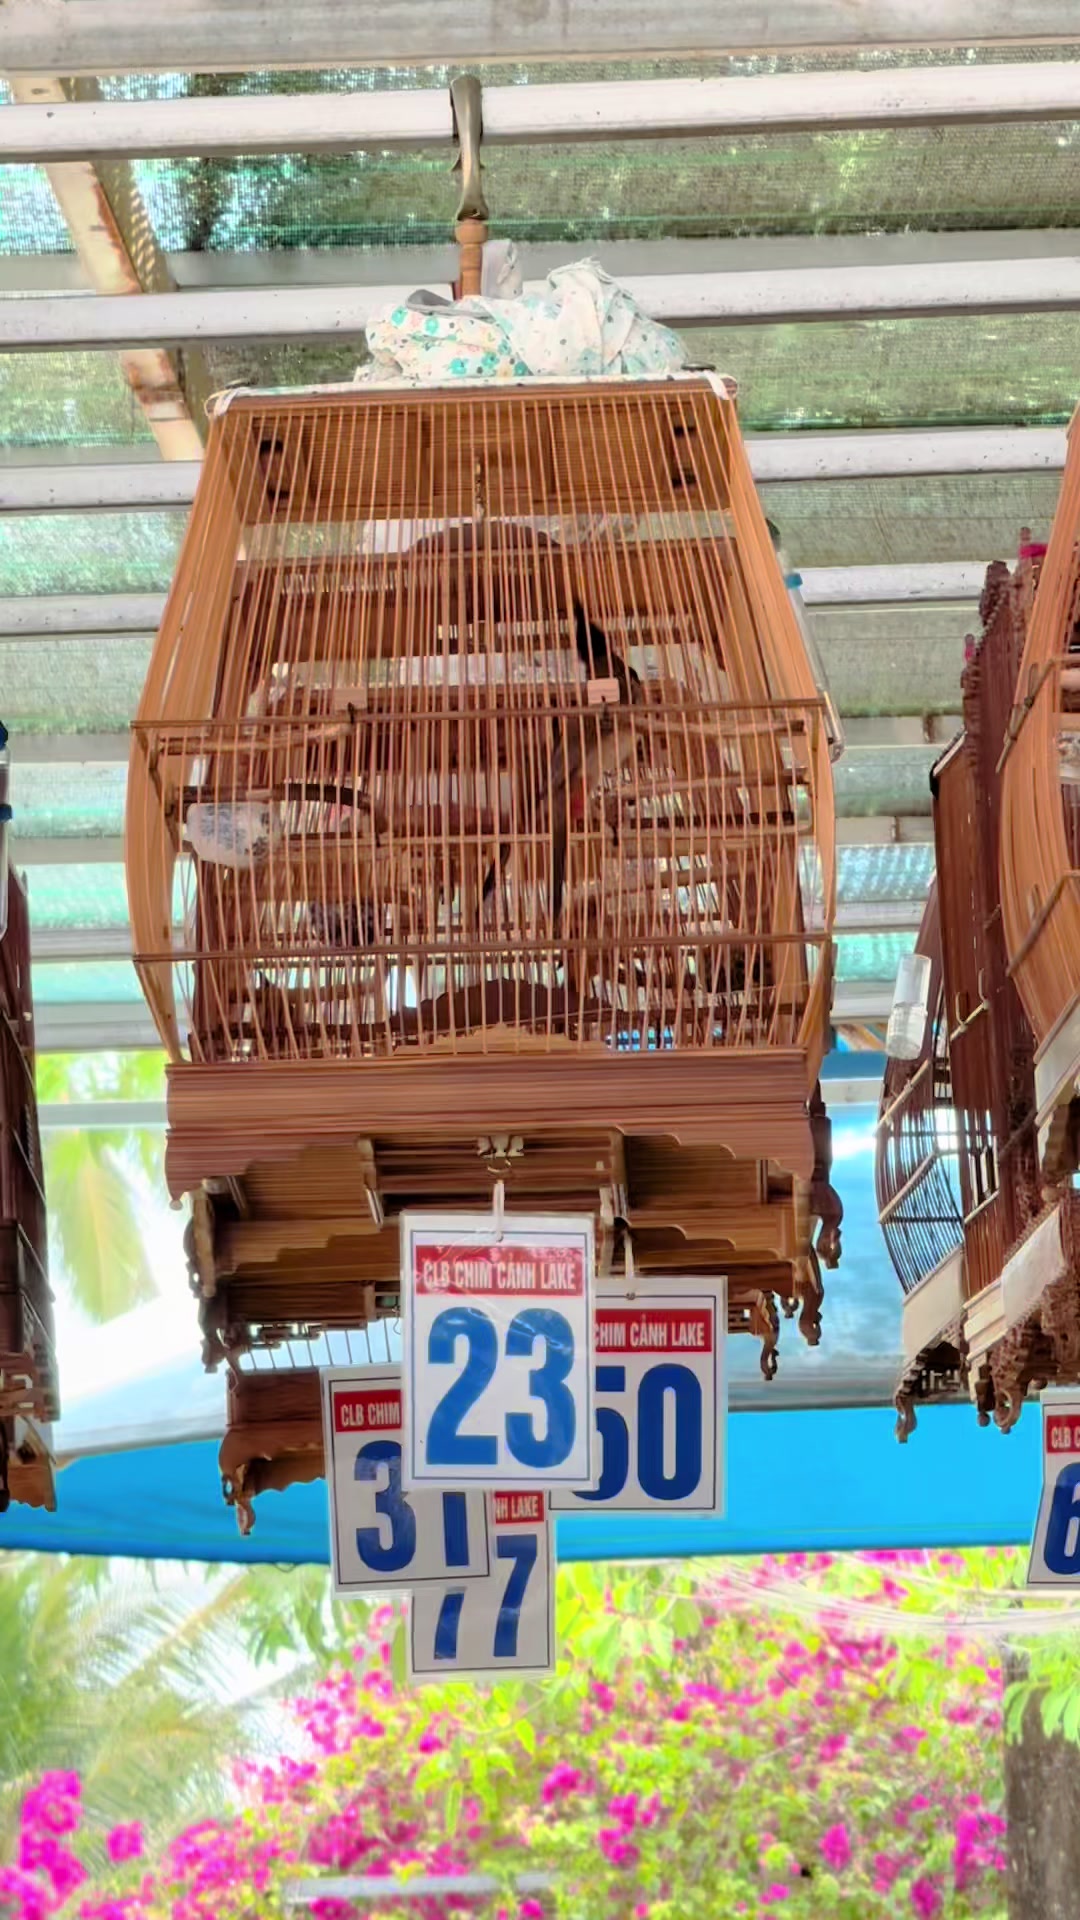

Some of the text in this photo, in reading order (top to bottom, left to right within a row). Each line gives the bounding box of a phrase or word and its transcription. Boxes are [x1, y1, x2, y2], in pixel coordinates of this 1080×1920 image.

[423, 1261, 450, 1289] CLB
[455, 1261, 493, 1289] CHIM
[540, 1262, 577, 1290] LAKE
[629, 1314, 668, 1347] CẢNH
[671, 1322, 705, 1347] LAKE
[426, 1306, 577, 1468] 23
[341, 1402, 400, 1428] CLB CHIM
[1051, 1426, 1071, 1449] CLB
[511, 1495, 539, 1519] LAKE
